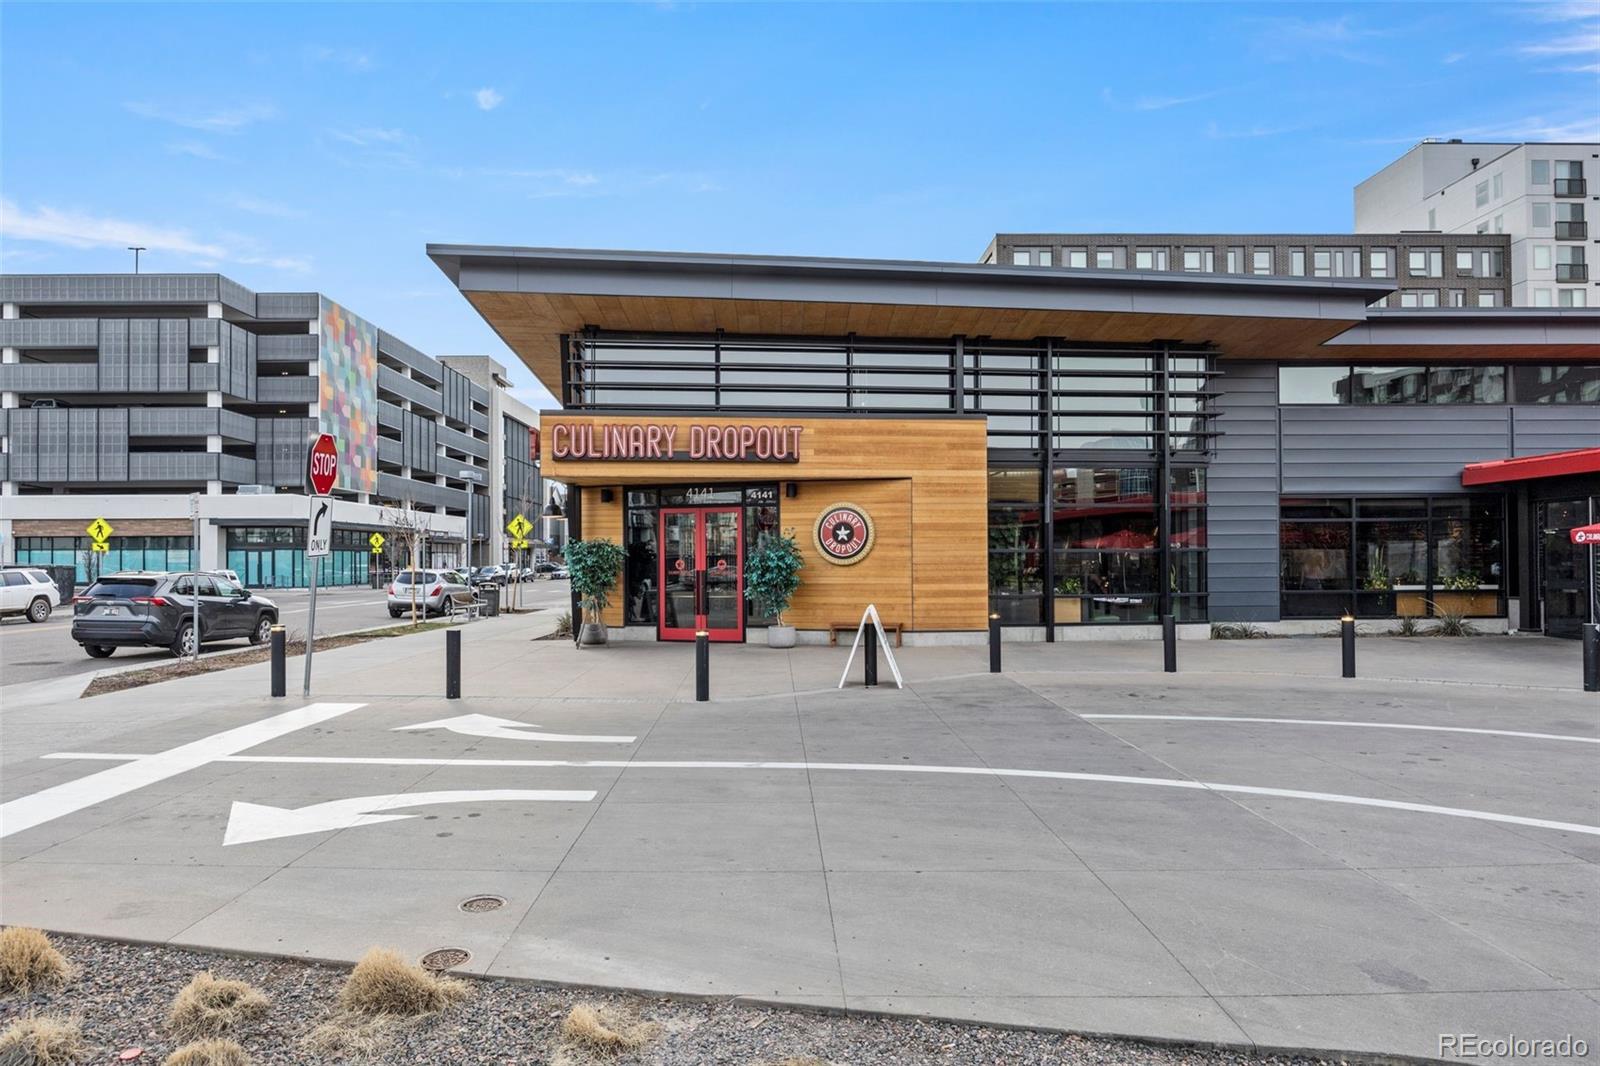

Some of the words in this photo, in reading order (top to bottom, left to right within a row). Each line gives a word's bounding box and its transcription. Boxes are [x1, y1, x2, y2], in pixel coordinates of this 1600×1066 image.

[553, 424, 677, 458] CULINARY
[689, 424, 803, 459] DROPOUT
[313, 452, 336, 477] STOP
[686, 487, 714, 499] 4141
[750, 490, 773, 499] 4141
[825, 513, 862, 529] CULINARY
[311, 539, 327, 551] ONLY
[825, 537, 861, 553] DROPOUT
